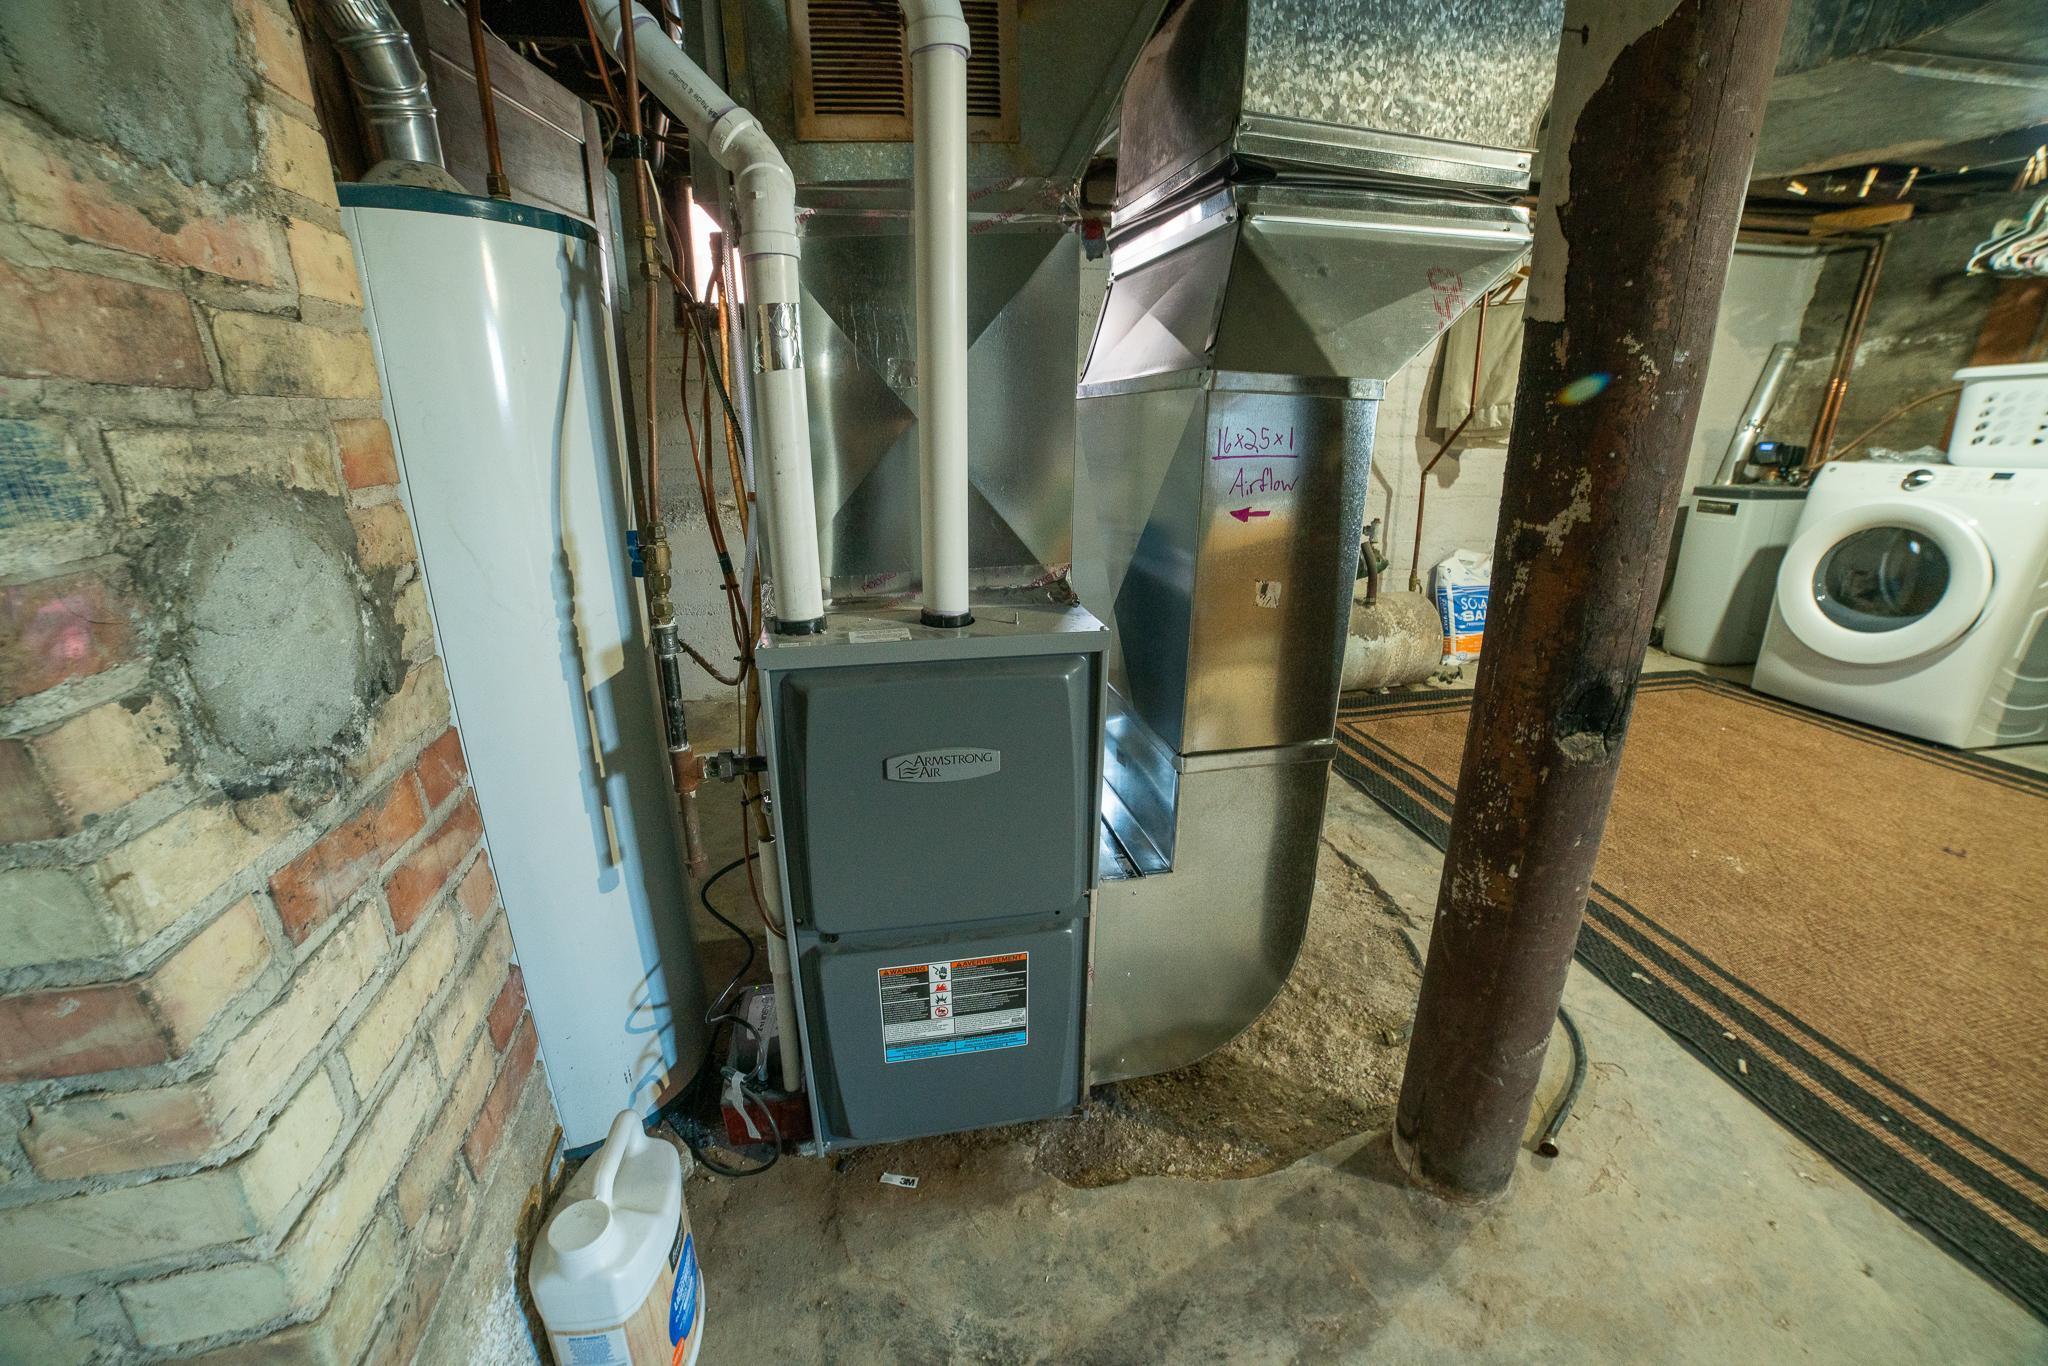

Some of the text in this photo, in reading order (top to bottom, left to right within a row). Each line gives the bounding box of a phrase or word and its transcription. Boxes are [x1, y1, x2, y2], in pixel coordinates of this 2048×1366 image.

[1229, 467, 1299, 498] Airflow
[914, 752, 993, 767] ARMSTRONG
[918, 766, 941, 779] AIR
[962, 954, 1023, 967] AVERTISSEMENT
[889, 965, 926, 976] WARNING
[899, 1177, 915, 1186] 3M
